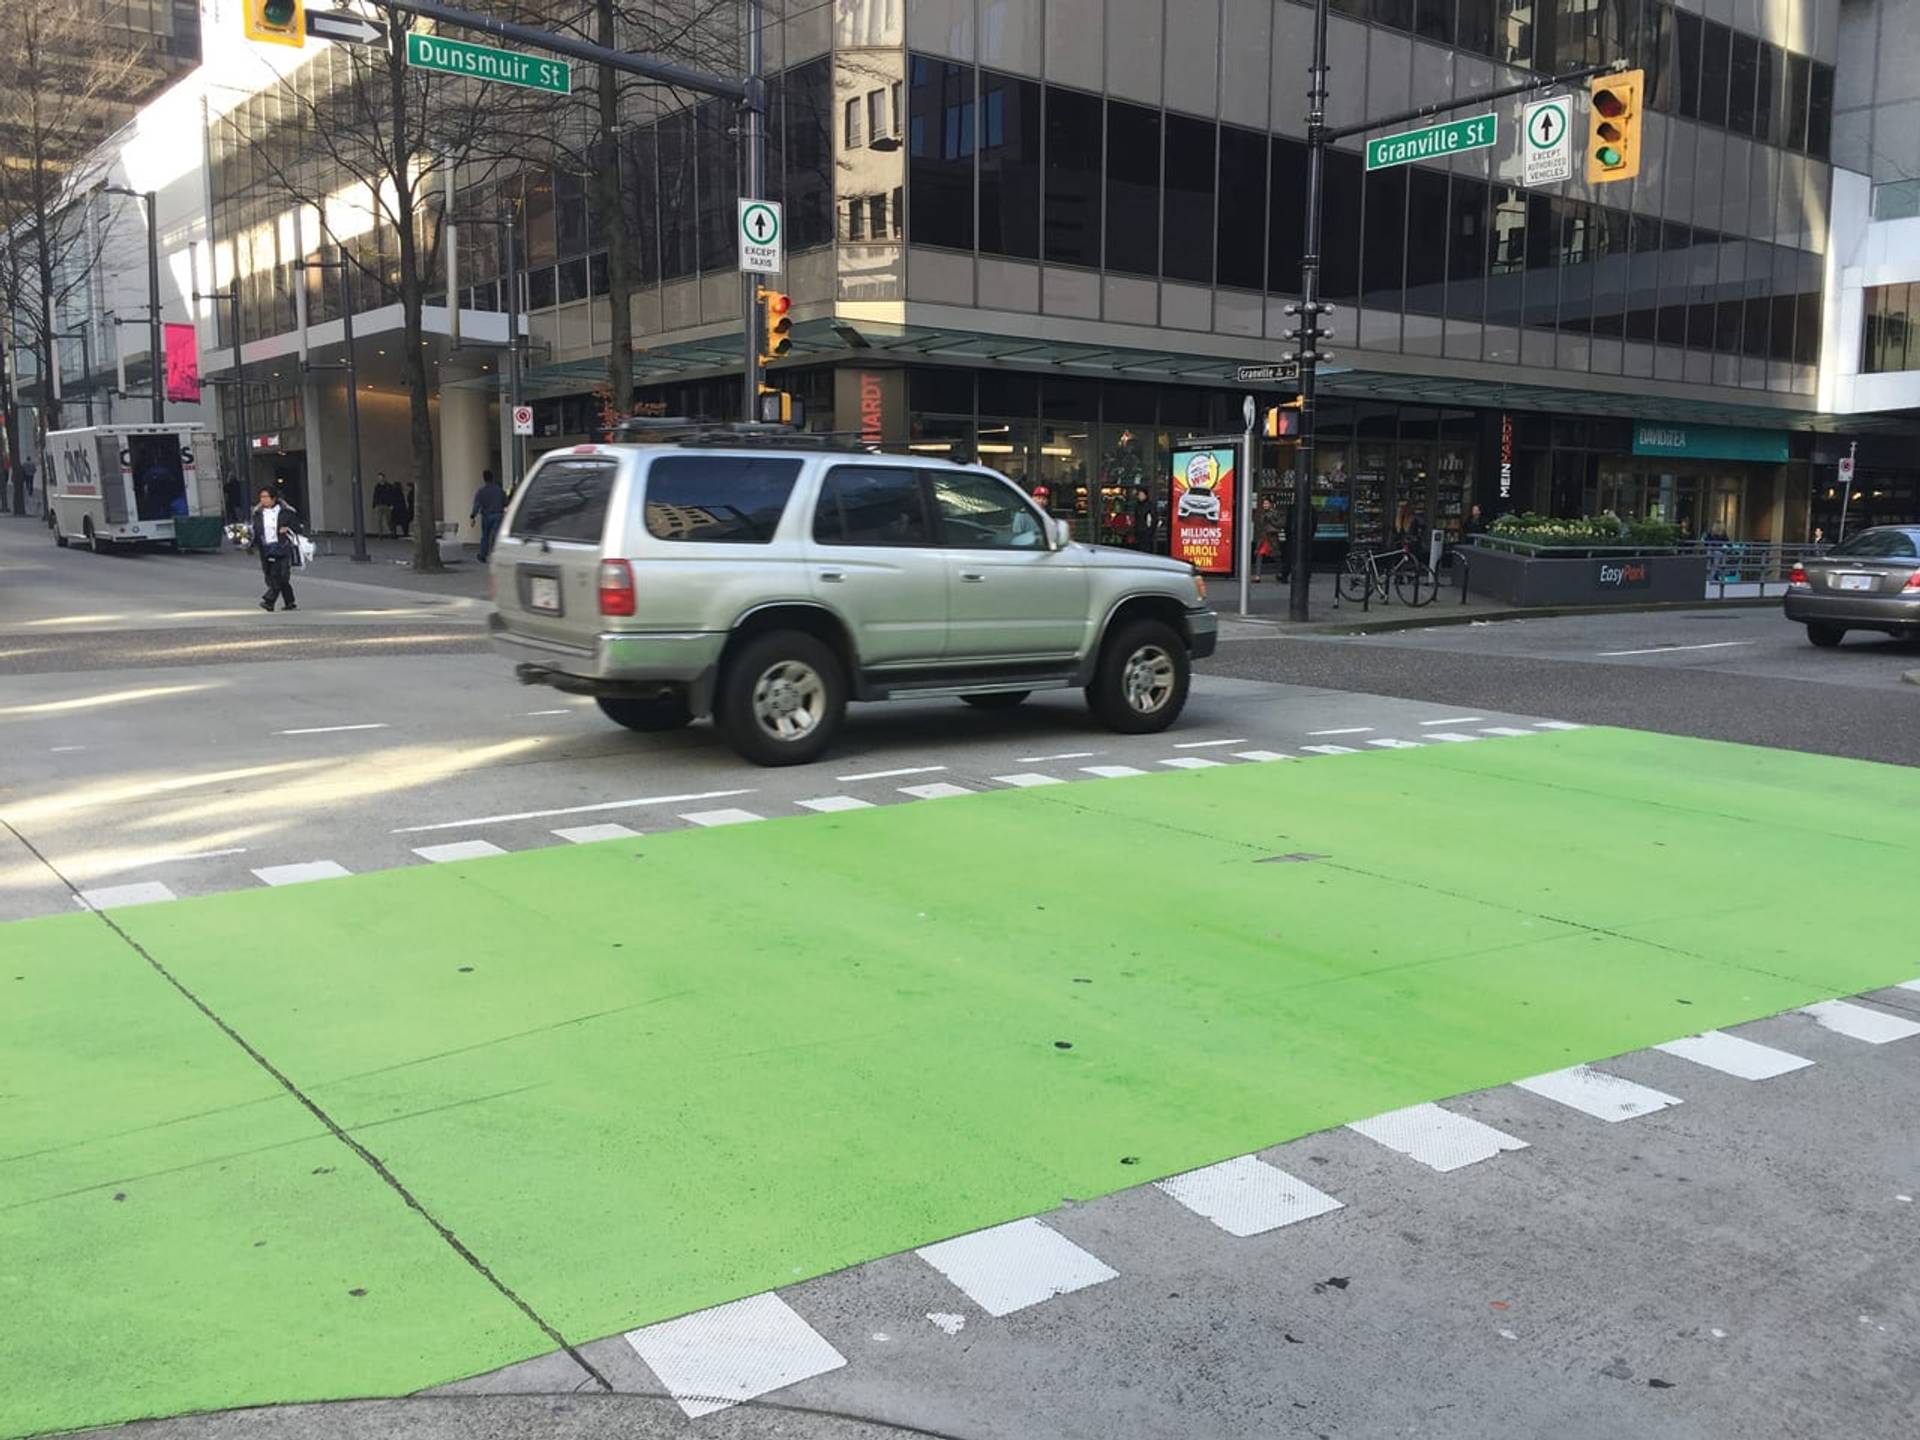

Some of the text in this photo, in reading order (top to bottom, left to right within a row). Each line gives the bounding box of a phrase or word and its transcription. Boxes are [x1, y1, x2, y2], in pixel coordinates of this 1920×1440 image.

[418, 40, 560, 87] Dunsmuir St
[1377, 121, 1485, 164] Granville St
[1532, 149, 1560, 161] EXCEPT
[1528, 157, 1567, 171] AUTHORIZED
[1530, 167, 1564, 180] VEHICLES
[745, 246, 776, 257] EXCEPT
[750, 257, 772, 268] TAXIS
[1500, 414, 1512, 498] MEINHARDT
[1180, 527, 1222, 539] MILLIONS
[1194, 556, 1213, 567] WIN
